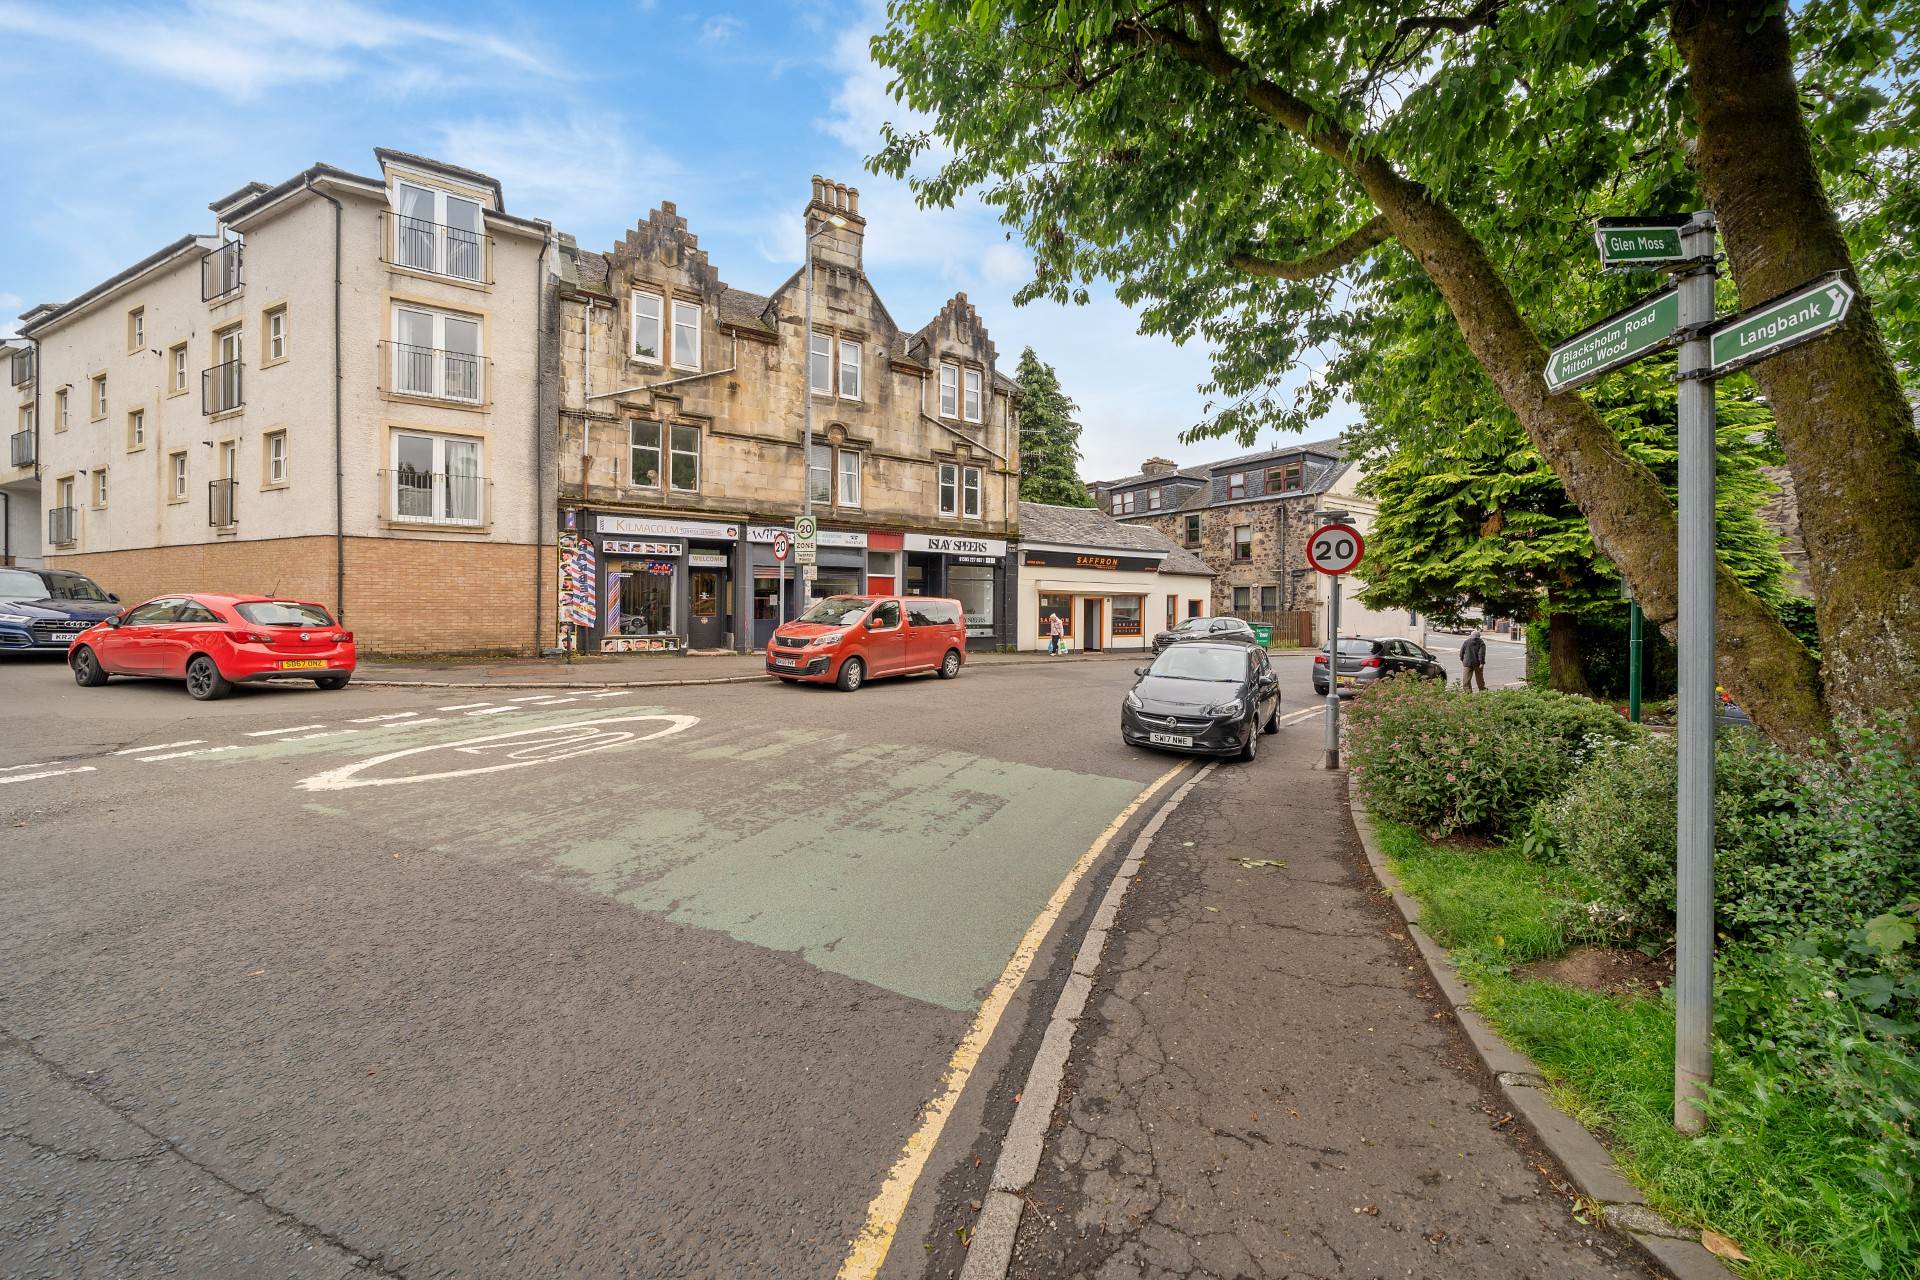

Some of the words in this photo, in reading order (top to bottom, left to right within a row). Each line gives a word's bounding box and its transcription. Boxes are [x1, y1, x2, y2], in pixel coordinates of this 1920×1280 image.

[1610, 236, 1636, 251] Glen
[1637, 235, 1665, 250] Moss
[1740, 302, 1822, 347] Langbank
[1562, 328, 1621, 364] Blacksholm
[1625, 309, 1657, 334] Road
[1561, 354, 1594, 378] Milton
[1596, 338, 1629, 361] Wood
[616, 519, 679, 534] KILMACOLM
[799, 525, 812, 534] 20
[775, 540, 786, 552] 20
[928, 539, 952, 550] ISLAY
[953, 540, 987, 552] SPEERS
[1314, 538, 1354, 561] 20
[1076, 556, 1118, 566] SAFFRON
[1154, 735, 1171, 744] SW17
[1172, 736, 1188, 745] NWE
